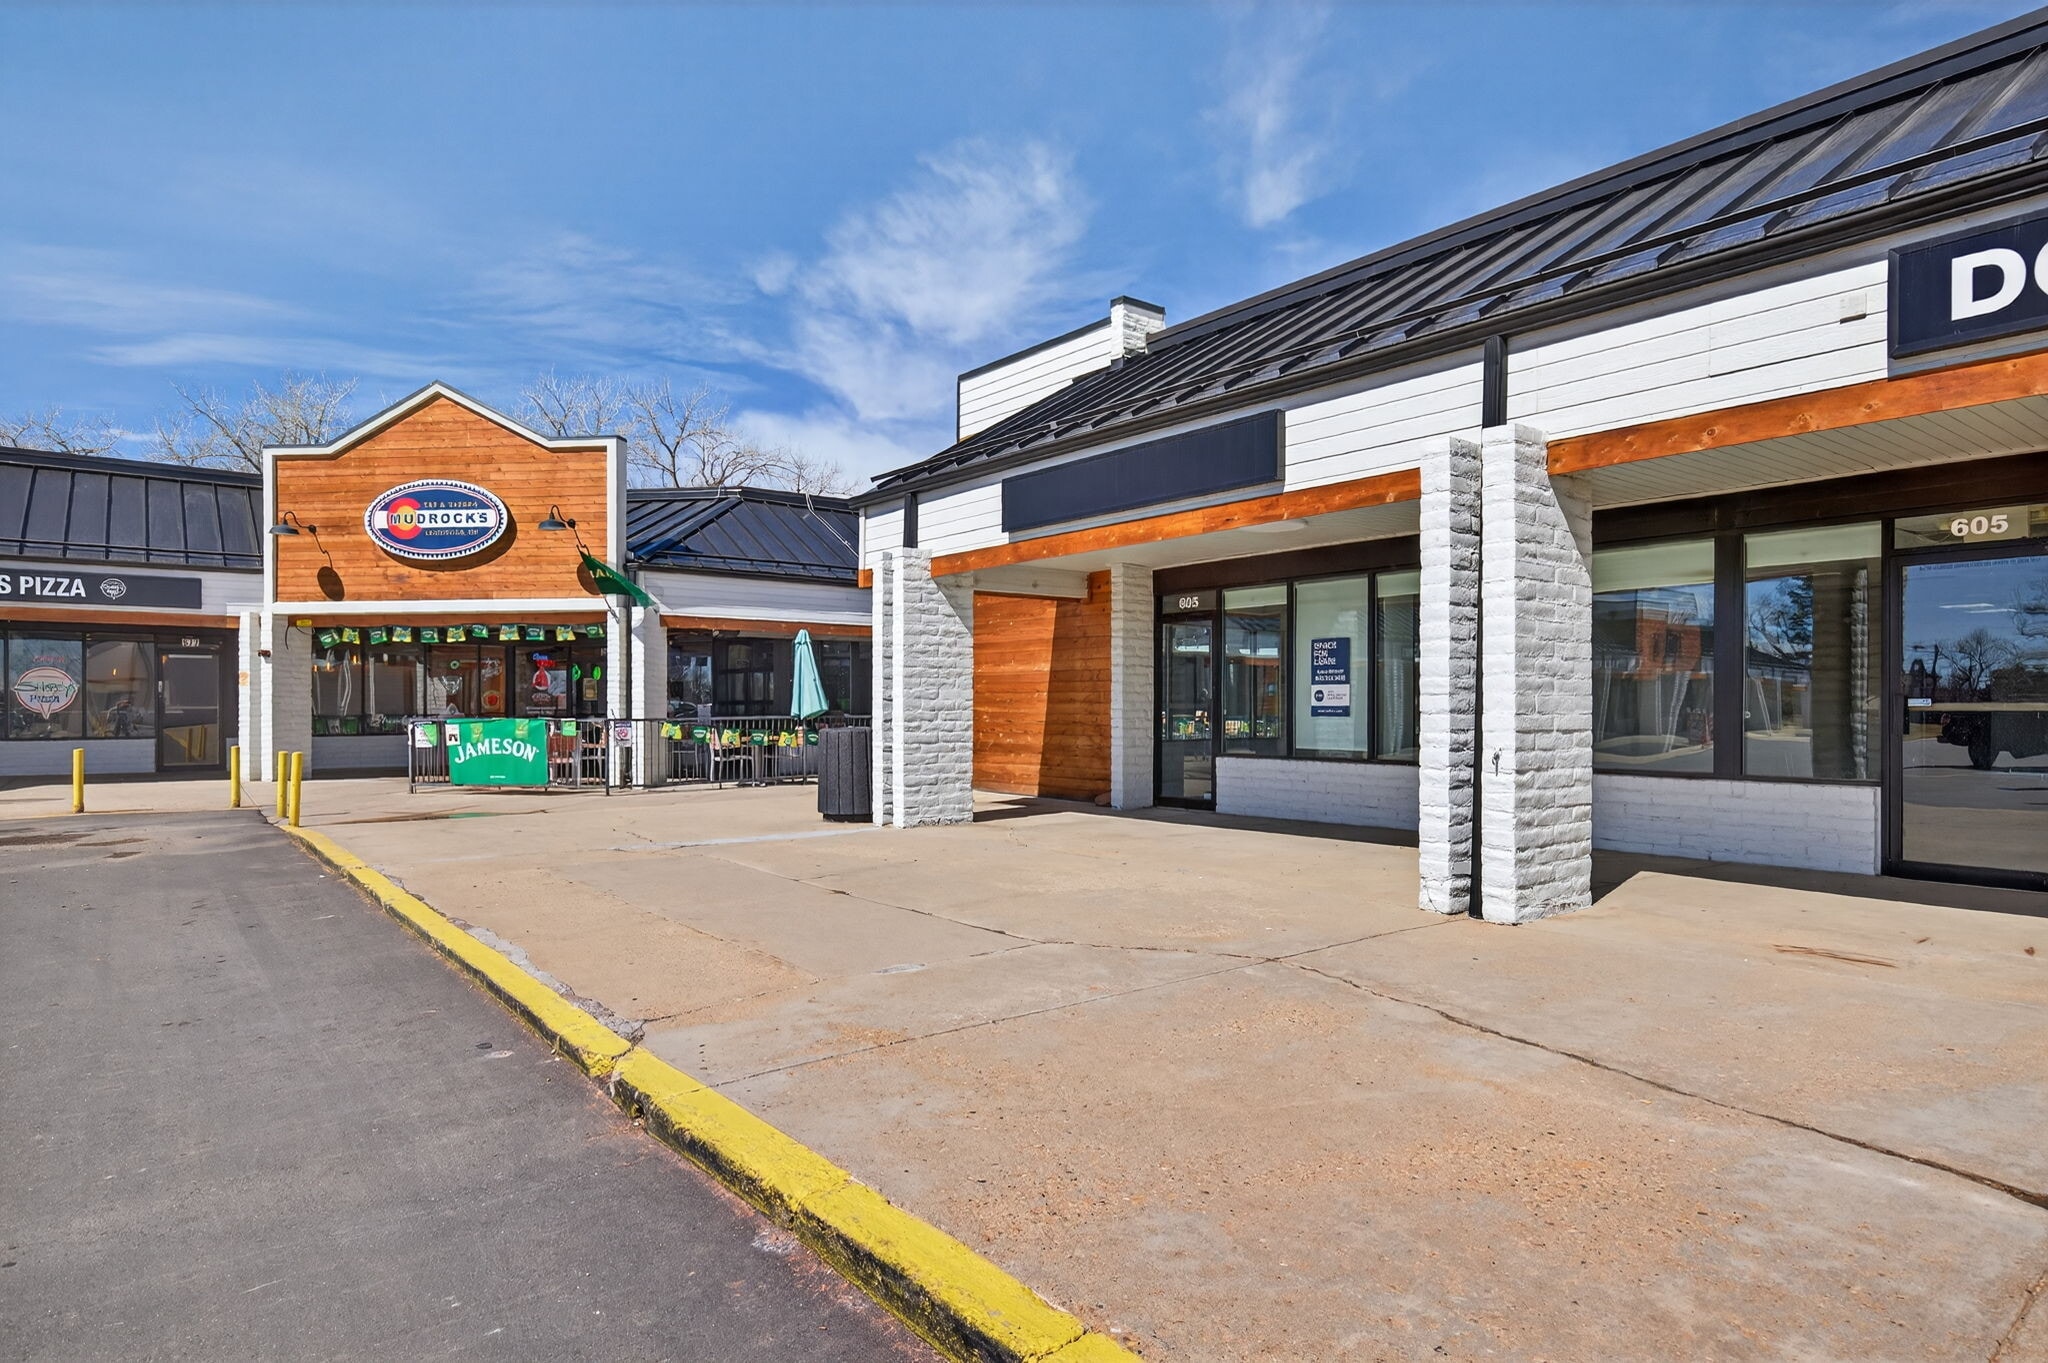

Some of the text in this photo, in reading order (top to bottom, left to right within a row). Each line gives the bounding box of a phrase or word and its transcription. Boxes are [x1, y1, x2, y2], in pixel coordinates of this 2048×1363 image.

[1951, 241, 2048, 321] D
[390, 512, 488, 524] MUDROCK'S
[1950, 513, 2009, 537] 605
[20, 575, 86, 597] PIZZA
[454, 738, 536, 764] JAMESON
